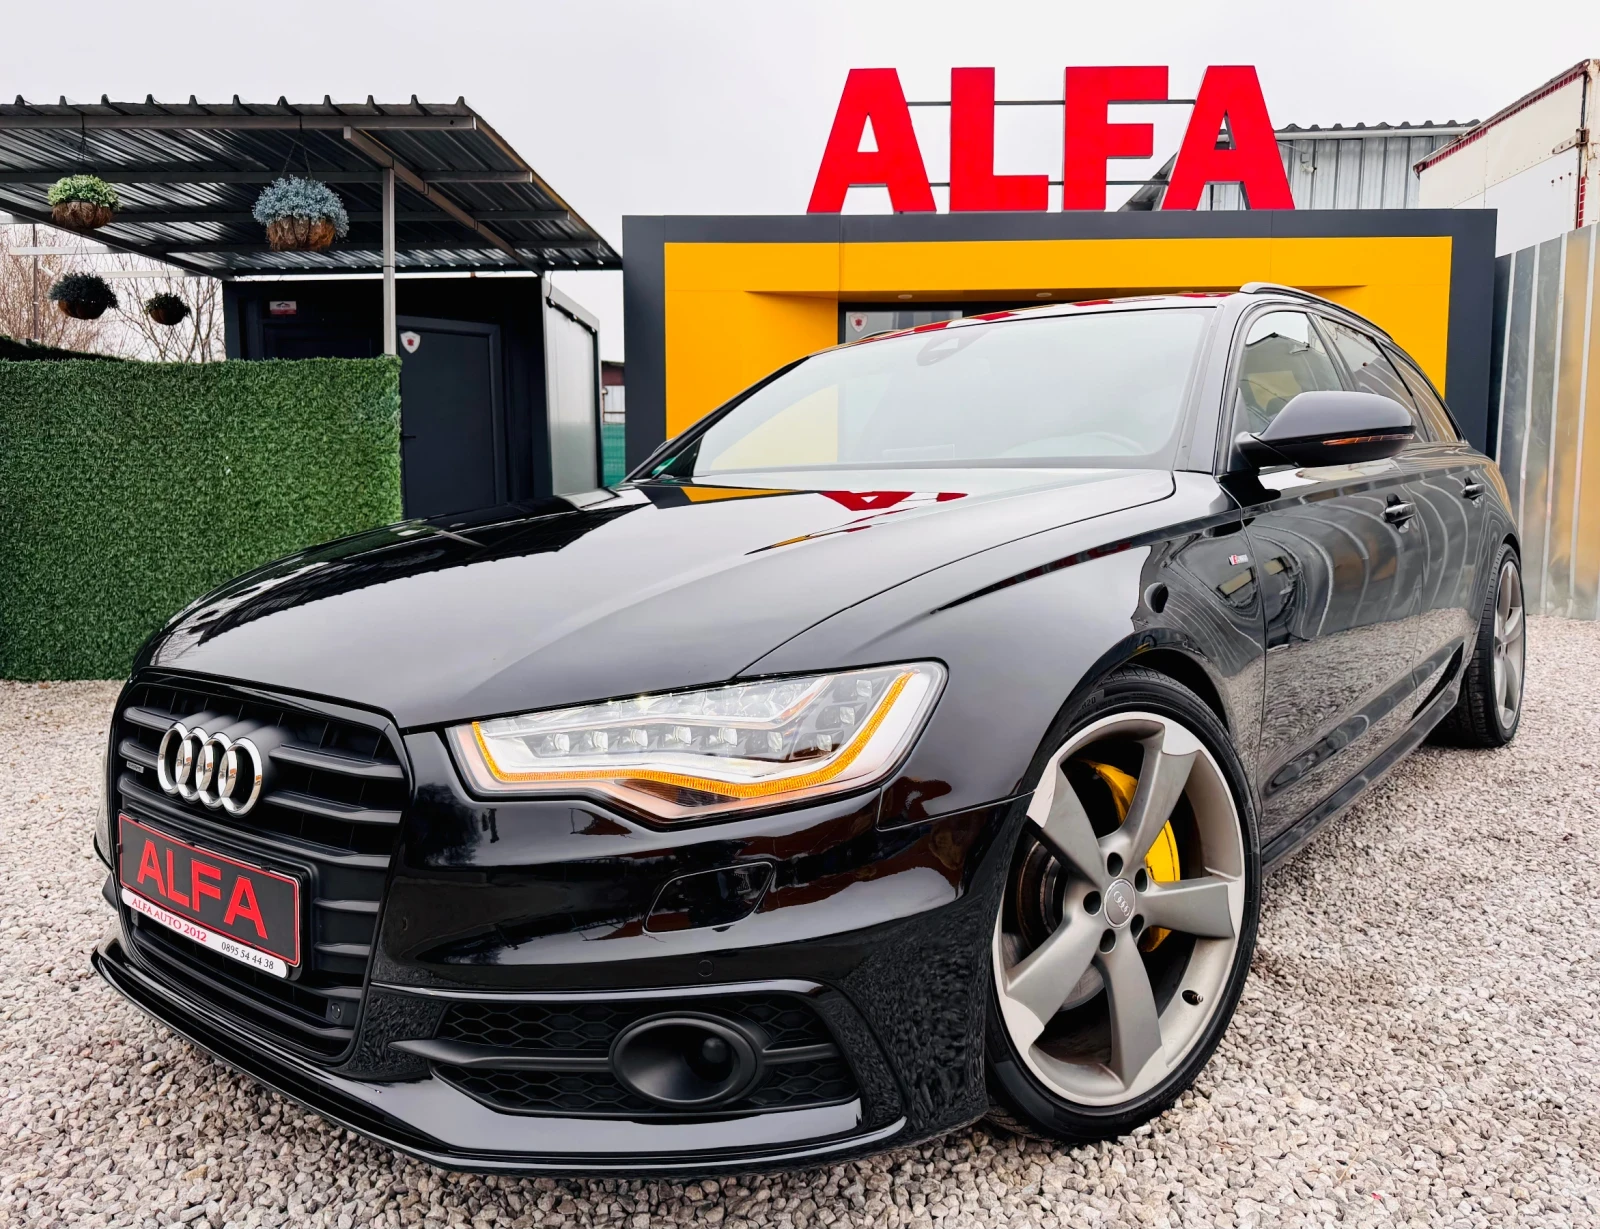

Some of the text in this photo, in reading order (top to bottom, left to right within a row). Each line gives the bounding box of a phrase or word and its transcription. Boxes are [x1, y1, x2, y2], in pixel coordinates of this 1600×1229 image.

[807, 65, 1295, 213] ALFA
[132, 898, 207, 942] ALFA AUTO 2012
[136, 838, 268, 940] ALFA
[221, 941, 274, 970] 0895 54 44 38
